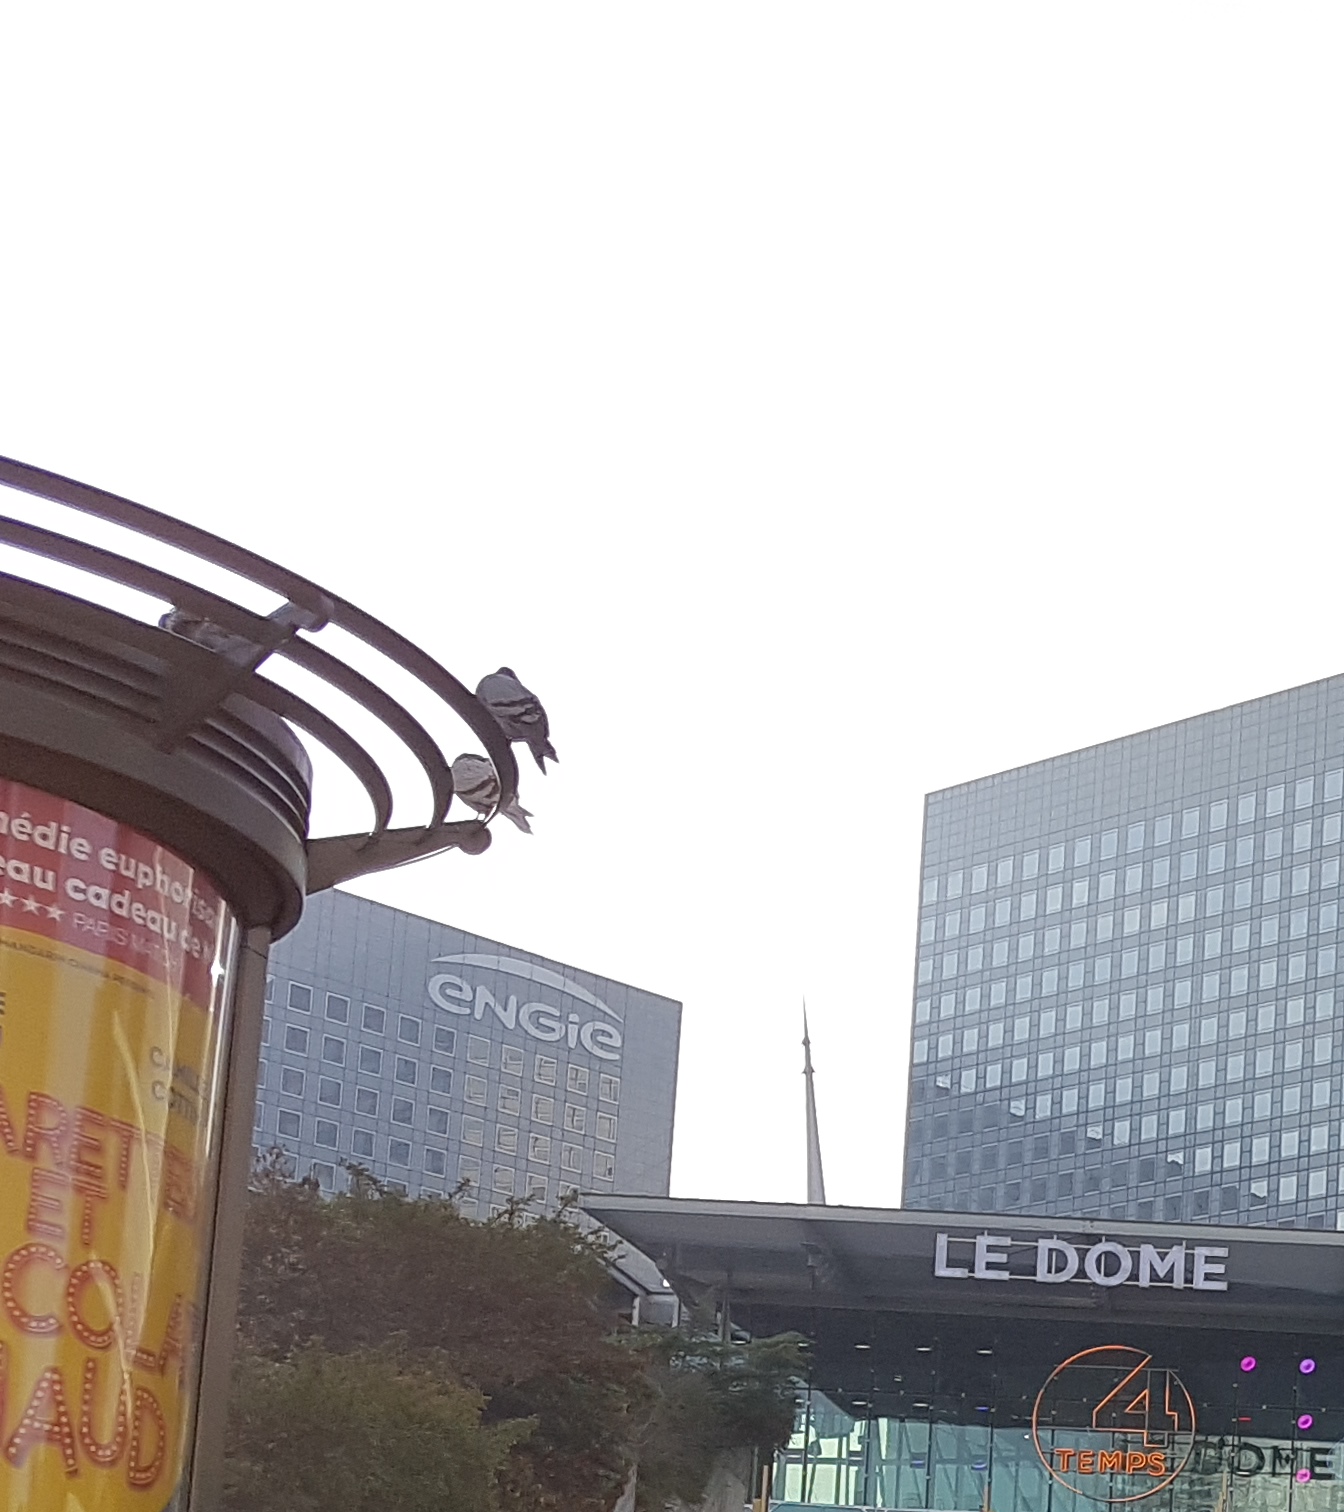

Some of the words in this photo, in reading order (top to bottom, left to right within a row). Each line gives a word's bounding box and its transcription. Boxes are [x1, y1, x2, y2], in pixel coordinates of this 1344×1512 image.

[65, 876, 177, 942] cadeau
[934, 1232, 1012, 1281] LE
[1035, 1238, 1229, 1292] DOME
[1055, 1447, 1168, 1478] TEMPS
